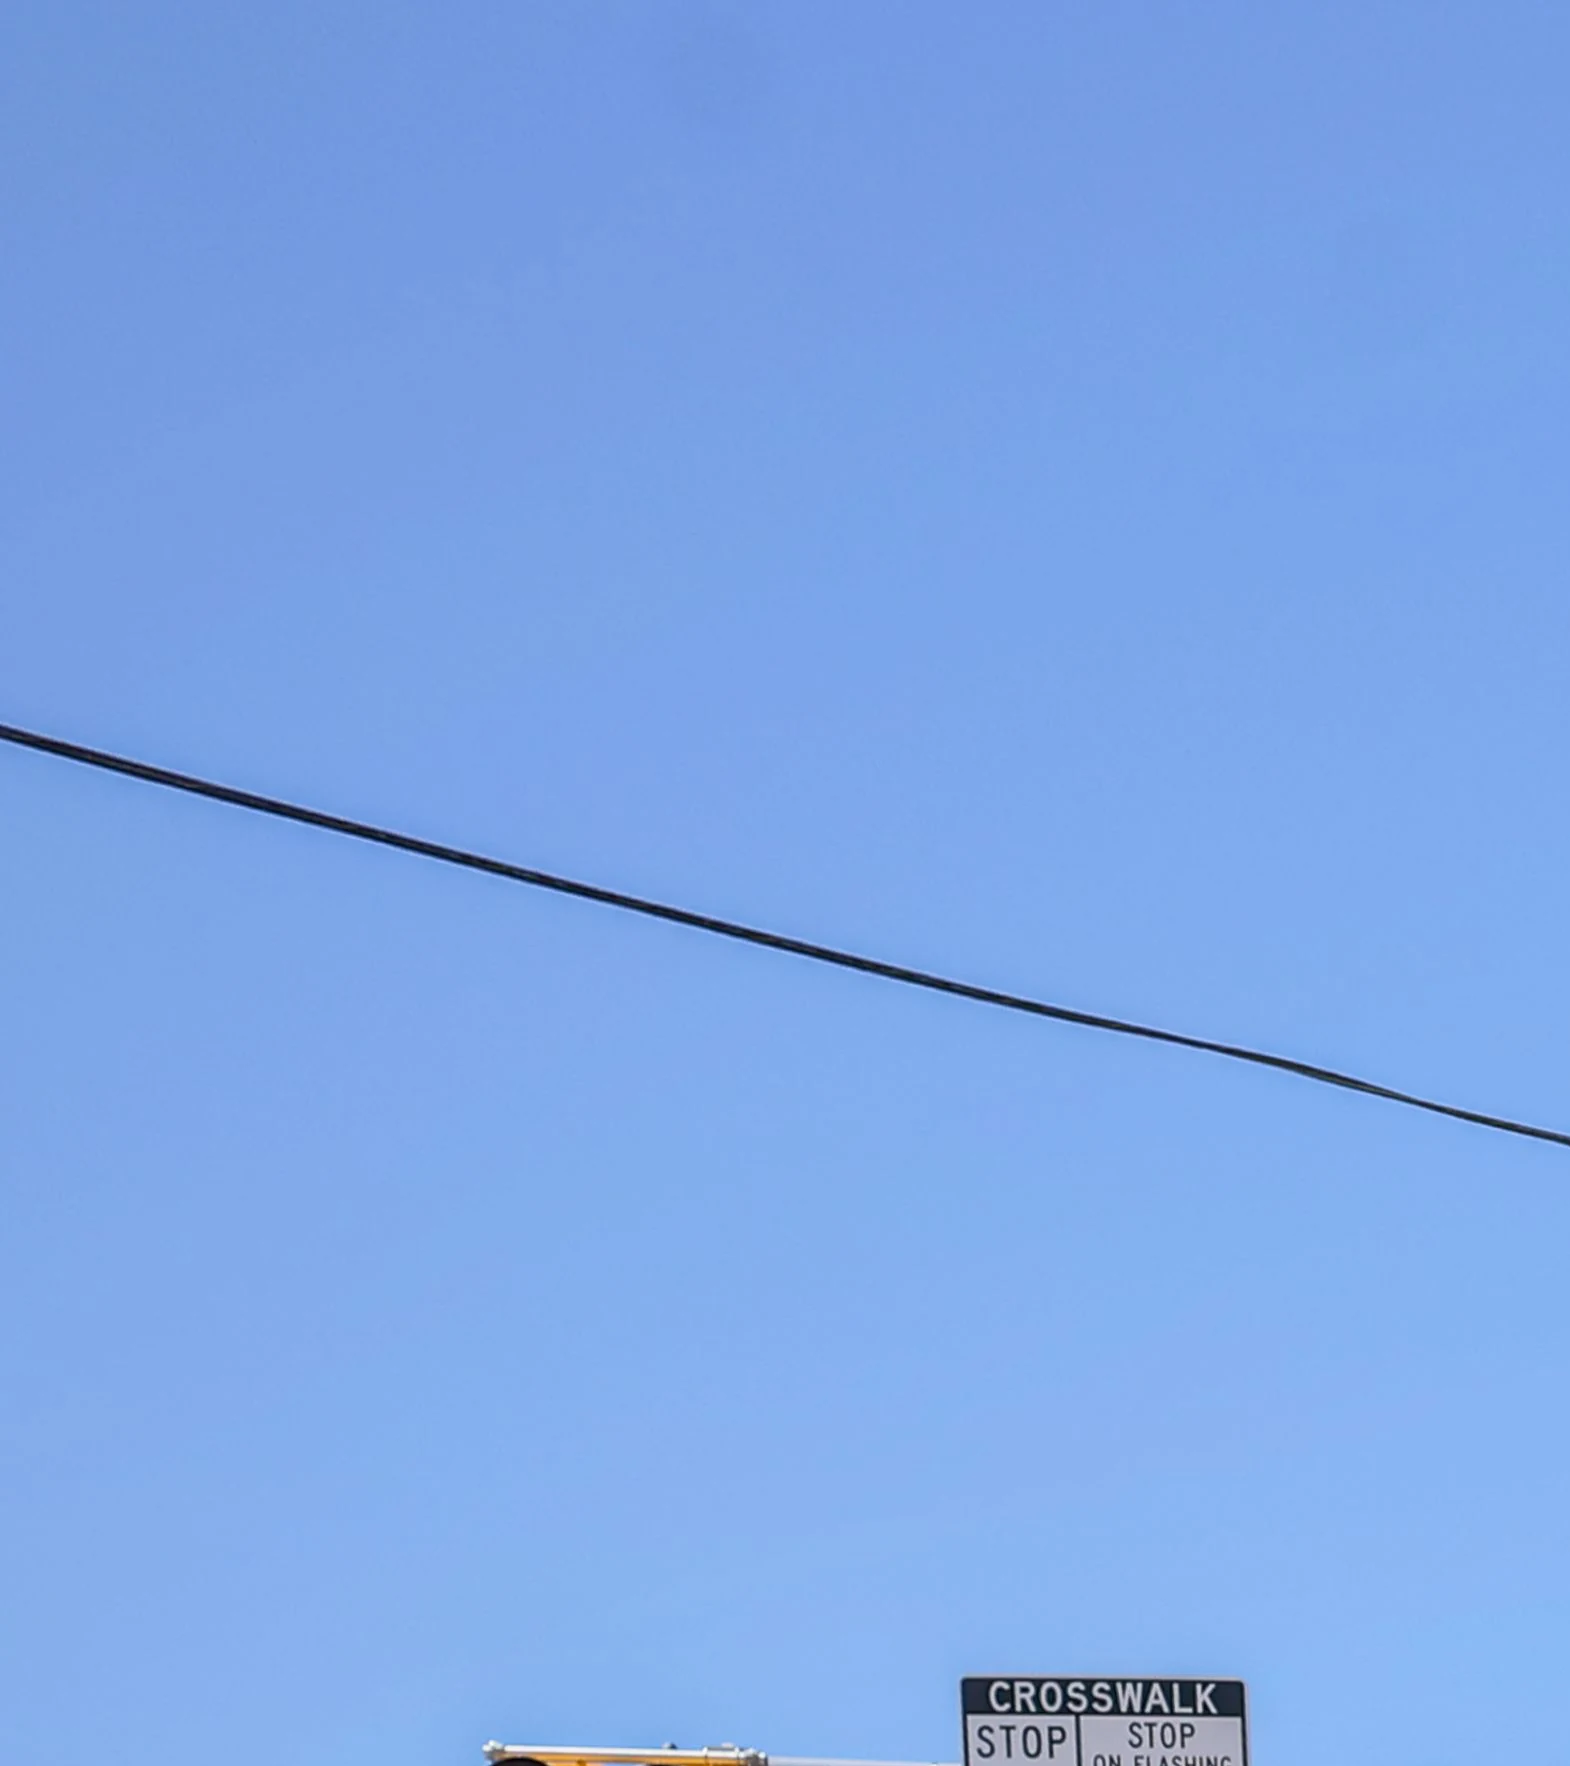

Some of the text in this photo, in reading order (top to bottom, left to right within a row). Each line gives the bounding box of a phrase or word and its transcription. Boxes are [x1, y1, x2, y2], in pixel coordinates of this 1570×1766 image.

[988, 1680, 1218, 1714] CROSSWALK
[975, 1725, 1067, 1759] STOP
[1127, 1722, 1196, 1749] STOP
